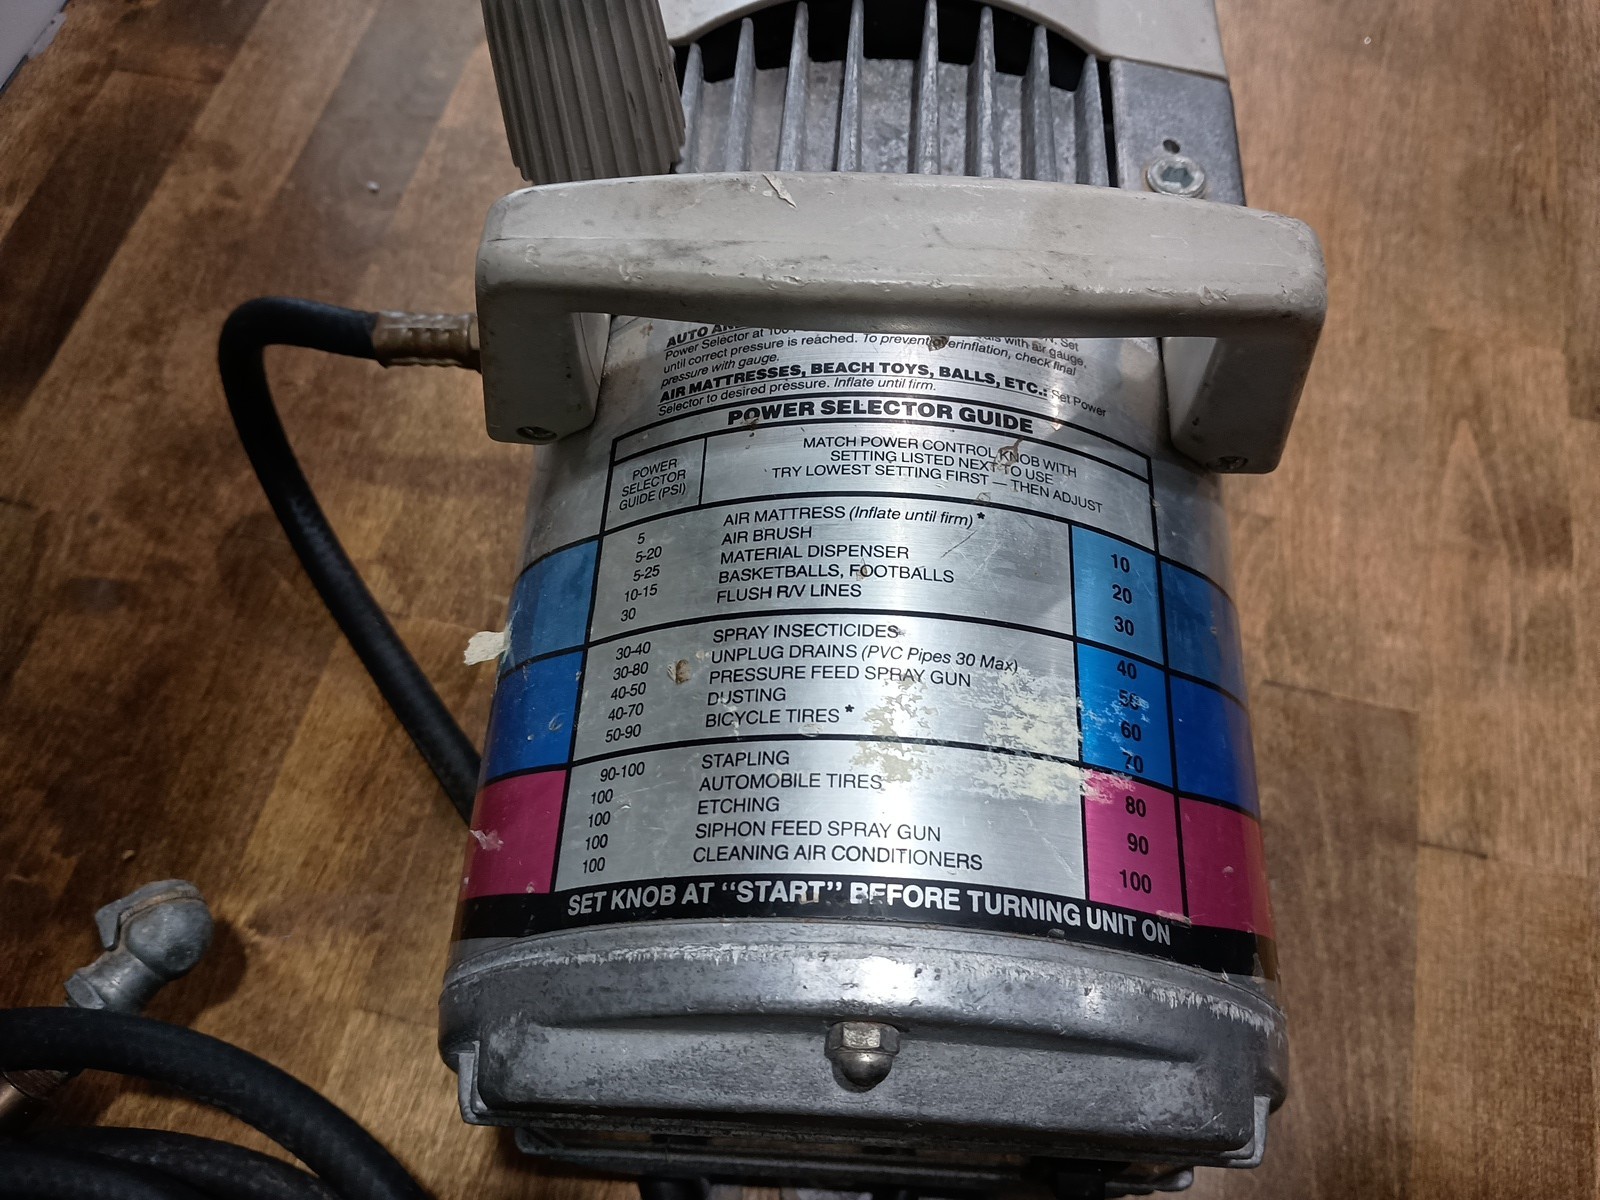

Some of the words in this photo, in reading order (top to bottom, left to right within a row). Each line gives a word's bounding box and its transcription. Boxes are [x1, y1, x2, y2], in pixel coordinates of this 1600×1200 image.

[665, 344, 699, 361] Power
[701, 331, 750, 350] Selector
[752, 328, 764, 339] at
[1004, 336, 1029, 349] with
[1031, 341, 1046, 353] air
[666, 327, 708, 348] AUTO
[1060, 337, 1079, 352] Set
[663, 358, 686, 374] until
[688, 348, 728, 367] correct
[730, 338, 784, 358] pressure
[787, 336, 798, 347] is
[801, 333, 858, 345] reached.
[863, 333, 877, 343] To
[879, 334, 930, 346] prevent
[1015, 351, 1050, 369] check
[1053, 360, 1077, 376] final
[660, 366, 709, 389] pressure
[711, 358, 735, 373] with
[738, 354, 780, 370] gauge.
[658, 397, 705, 416] Selector
[707, 394, 718, 404] to
[720, 384, 767, 400] desired
[769, 379, 830, 394] pressure.
[834, 377, 874, 389] Inflate
[877, 378, 906, 390] until
[908, 379, 937, 391] firm.
[660, 386, 686, 403] AIR
[688, 364, 807, 397] MATTRESSES,
[811, 362, 875, 375] BEACH
[879, 362, 934, 379] TOYS,
[939, 366, 1001, 388] BALLS,
[1004, 376, 1048, 397] ETC.:
[1051, 389, 1071, 404] Set
[1073, 396, 1107, 417] Power
[727, 401, 815, 425] POWER
[820, 399, 953, 420] SELECTOR
[959, 407, 1034, 434] GUIDE
[803, 436, 855, 449] MATCH
[861, 436, 919, 450] POWER
[922, 439, 996, 458] CONTROL
[999, 450, 1040, 468] KNOB
[1042, 458, 1078, 478] WITH
[830, 450, 899, 462] SETTING
[901, 450, 955, 467] LISTED
[958, 456, 998, 473] NEXT
[1001, 463, 1022, 477] TO
[1025, 468, 1054, 485] USE
[632, 458, 678, 480] POWER
[621, 469, 687, 497] SELECTOR
[771, 465, 802, 479] TRY
[805, 464, 871, 477] LOWEST
[875, 465, 942, 481] SETTING
[945, 469, 989, 486] FIRST
[1011, 479, 1050, 498] THEN
[1052, 489, 1103, 513] ADJUST
[619, 492, 656, 511] GUIDE
[658, 482, 687, 501] (PSI)
[723, 511, 750, 526] AIR
[754, 506, 846, 523] MATTRESS
[849, 506, 901, 522] (Inflate
[904, 508, 937, 523] until
[940, 511, 974, 529] firm)
[637, 532, 645, 545] 5
[721, 531, 748, 546] AIR
[752, 526, 812, 542] BRUSH
[635, 546, 662, 563] 5-20
[720, 545, 802, 565] MATERIAL
[807, 544, 909, 560] DISPENSER
[1110, 553, 1130, 573] 10
[633, 564, 660, 582] 5-25
[718, 564, 844, 584] BASKETBALLS,
[849, 564, 954, 584] FOOTBALLS
[624, 583, 658, 602] 10-15
[716, 586, 772, 604] FLUSH
[776, 585, 805, 599] R/V
[810, 584, 862, 598] LINES
[1112, 584, 1133, 605] 20
[620, 607, 636, 622] 30
[712, 624, 769, 643] SPRAY
[773, 623, 899, 639] INSECTICIDES
[1114, 615, 1135, 637] 30
[615, 641, 651, 660] 30-40
[711, 645, 784, 664] UNPLUG
[789, 644, 858, 659] DRAINS
[861, 644, 903, 662] (PVC
[907, 647, 951, 666] Pipes
[955, 651, 976, 667] 30
[980, 654, 1018, 675] Max)
[613, 661, 649, 681] 30-80
[709, 665, 806, 684] PRESSURE
[811, 665, 859, 680] FEED
[864, 665, 926, 682] SPRAY
[930, 670, 972, 687] GUN
[1117, 660, 1137, 680] 40
[610, 681, 646, 700] 40-50
[707, 687, 787, 706] DUSTING
[608, 702, 644, 721] 40-70
[705, 709, 781, 728] BICYCLE
[785, 707, 840, 723] TIRES
[605, 723, 641, 743] 50-90
[1121, 720, 1141, 742] 60
[701, 750, 790, 769] STAPLING
[1122, 751, 1144, 773] 70
[600, 761, 645, 782] 90-100
[699, 772, 821, 792] AUTOMOBILE
[826, 773, 883, 790] TIRES
[591, 788, 613, 805] 100
[697, 796, 780, 815] ETCHING
[1125, 795, 1146, 818] 80
[588, 811, 611, 828] 100
[695, 820, 766, 839] SIPHON
[770, 820, 822, 836] FEED
[827, 820, 892, 839] SPRAY
[897, 824, 942, 842] GUN
[585, 833, 608, 851] 100
[1127, 832, 1149, 855] 90
[583, 856, 606, 874] 100
[693, 844, 789, 863] CLEANING
[793, 844, 826, 861] AIR
[831, 845, 983, 871] CONDITIONERS
[1119, 869, 1152, 894] 100
[567, 891, 607, 916] SET
[610, 884, 676, 910] KNOB
[681, 882, 715, 905] AT
[850, 881, 961, 911] BEFORE
[966, 889, 1081, 927] TURNING
[1086, 906, 1137, 938] UNIT
[1141, 918, 1172, 946] ON
